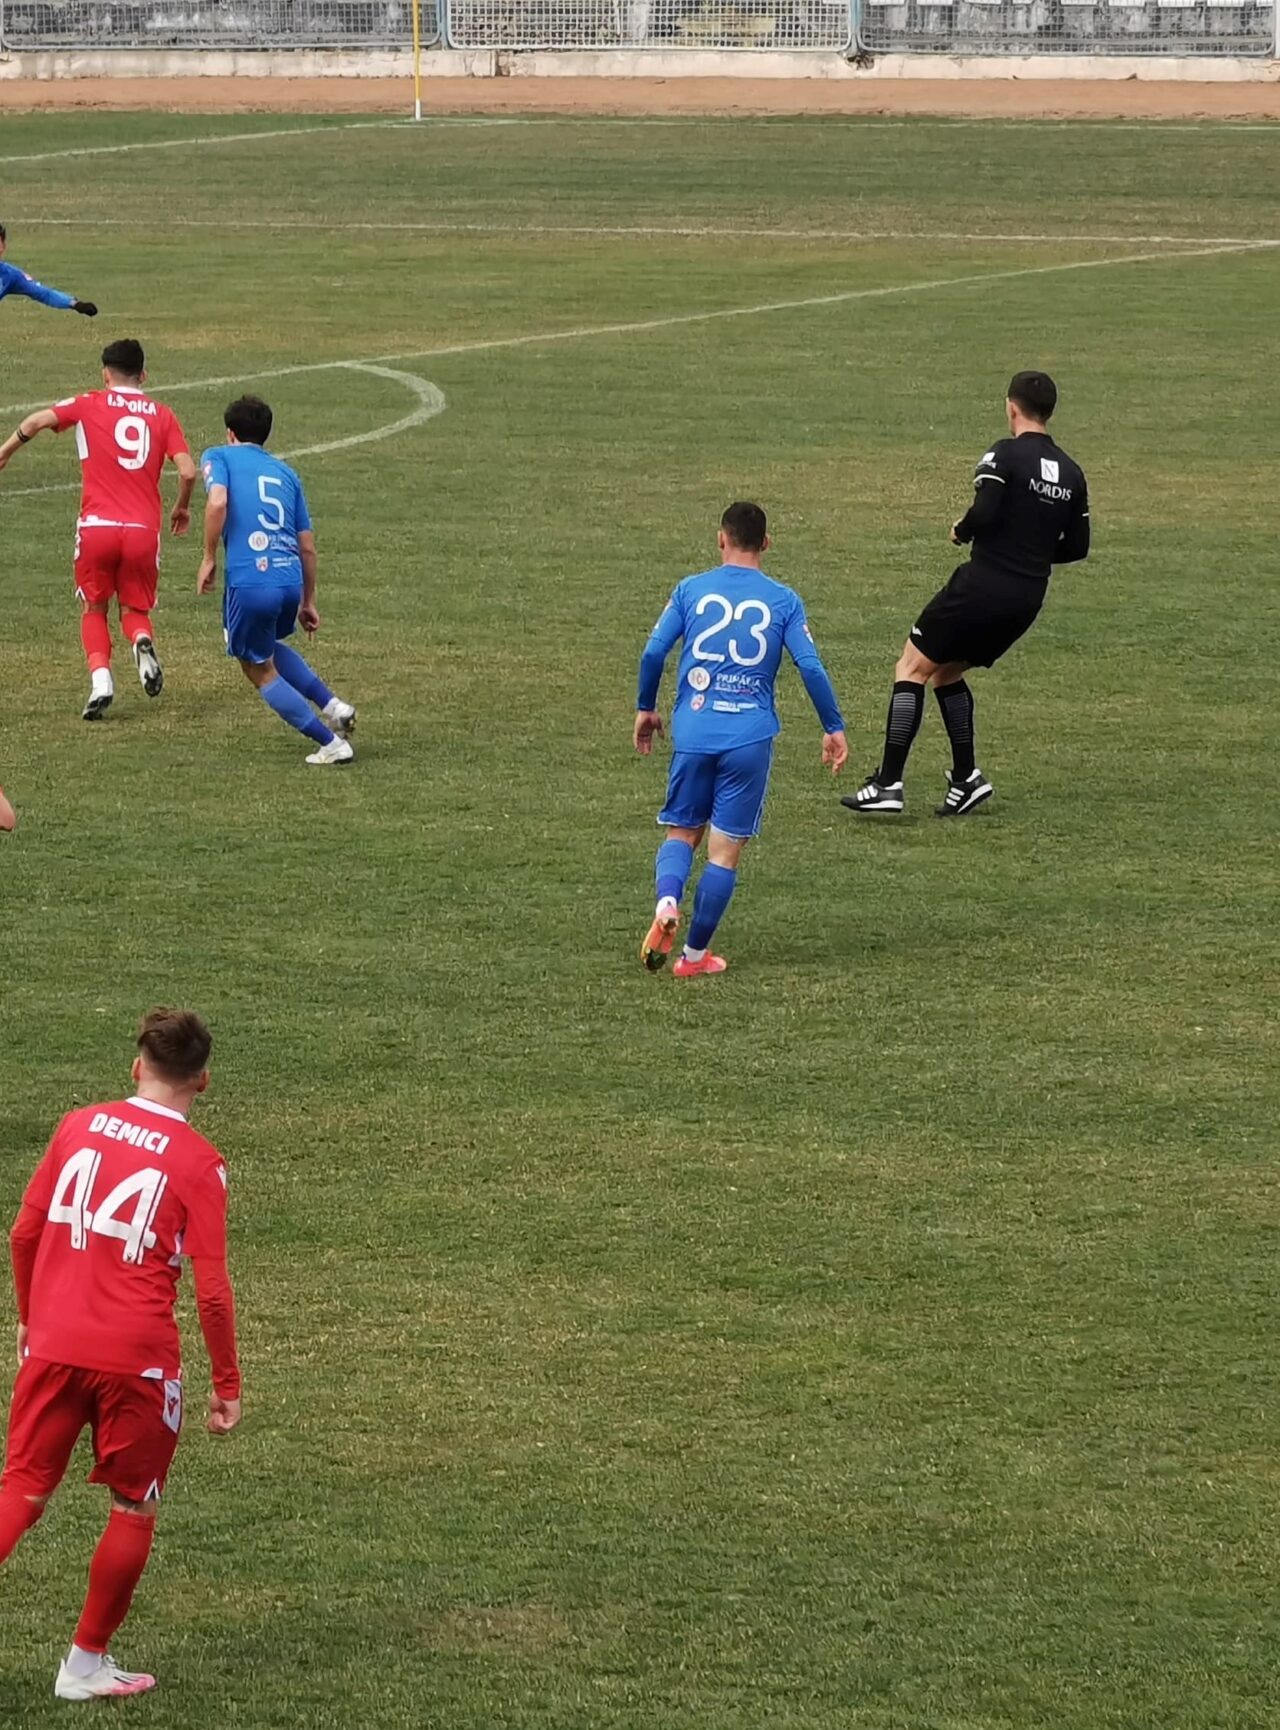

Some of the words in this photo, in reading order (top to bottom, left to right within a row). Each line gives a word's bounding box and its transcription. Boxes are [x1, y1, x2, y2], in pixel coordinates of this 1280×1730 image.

[114, 415, 150, 470] 9
[257, 475, 285, 530] 5
[1029, 478, 1072, 501] NORDIS
[692, 594, 772, 666] 23
[88, 1113, 170, 1155] DEMICI
[47, 1147, 168, 1266] 44
